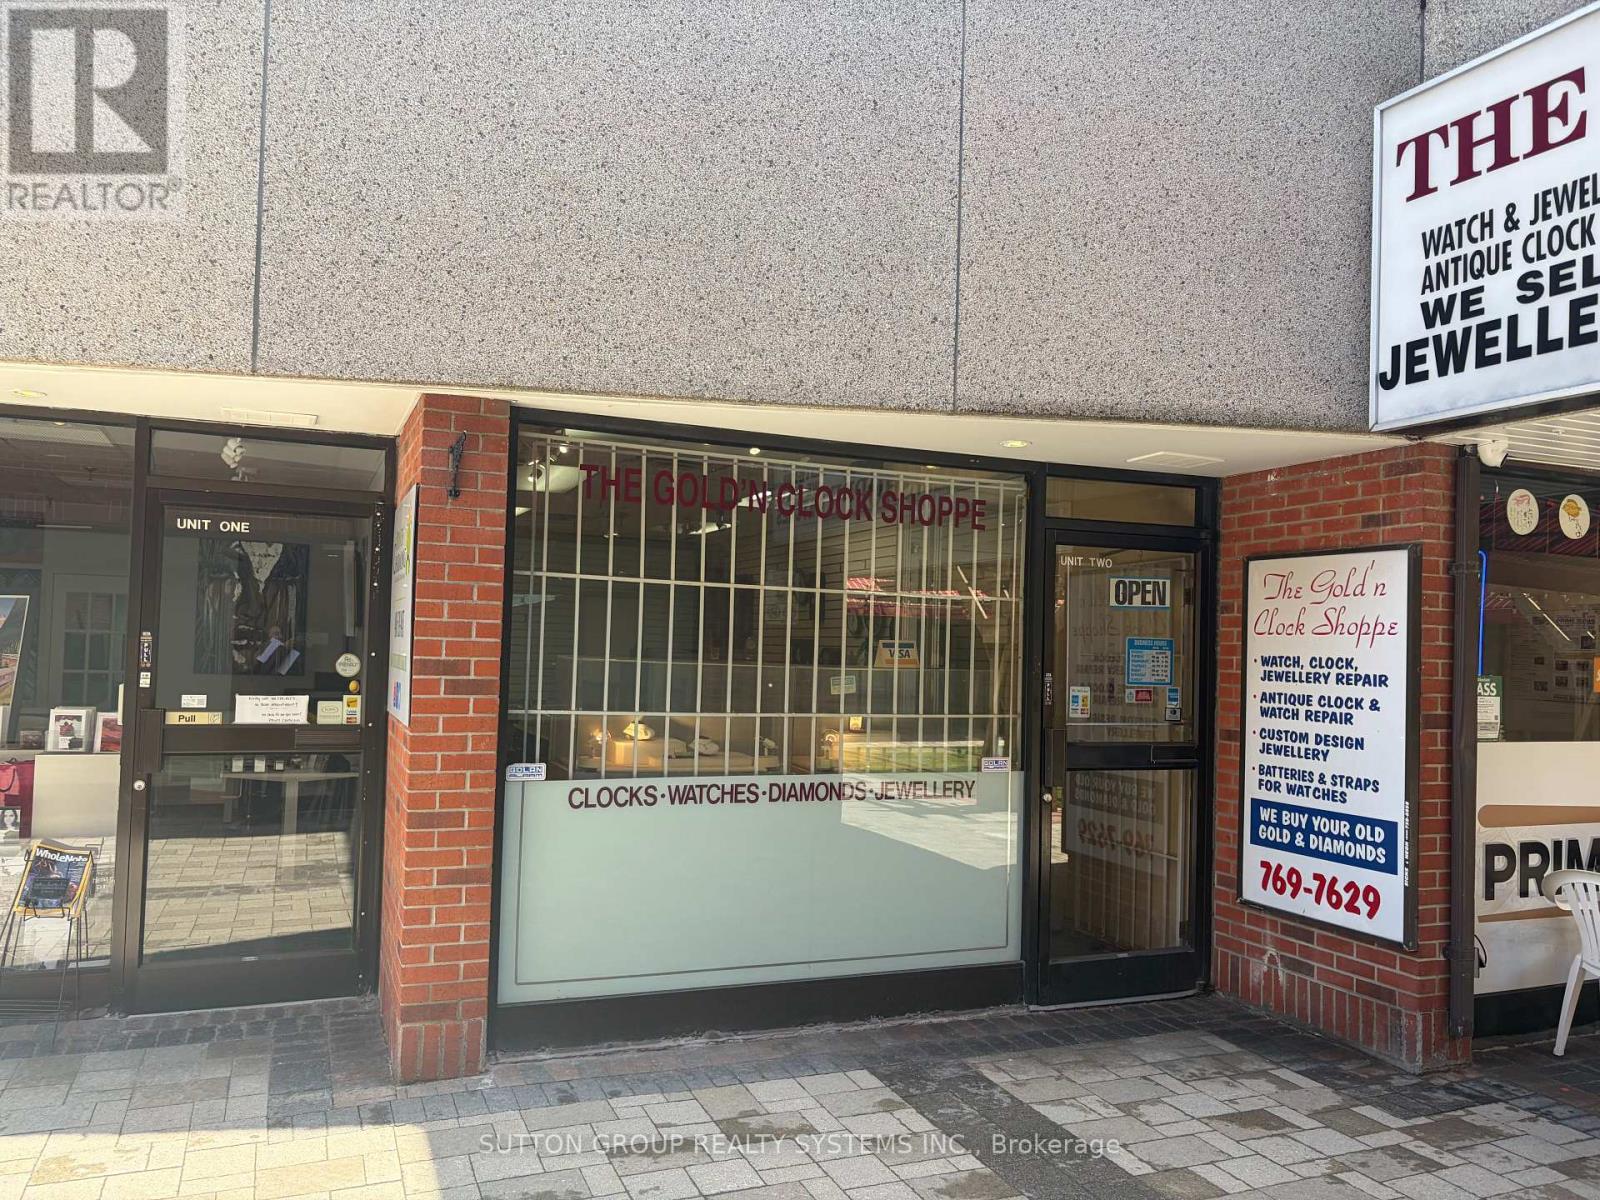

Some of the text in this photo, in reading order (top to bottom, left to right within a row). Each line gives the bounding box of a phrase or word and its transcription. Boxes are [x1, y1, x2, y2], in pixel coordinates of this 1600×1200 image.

[1396, 66, 1588, 203] THE
[1421, 208, 1495, 260] WATCH
[1503, 202, 1521, 233] &
[1421, 213, 1596, 296] ANTIQUE CLOCK
[1420, 254, 1600, 330] WE SEL
[1379, 293, 1599, 391] JEWELLE
[580, 464, 987, 532] THE GOLD'N CLOCK SHOPPE
[176, 517, 251, 534] UNIT ONE
[1060, 556, 1114, 569] UNIT TWO
[1114, 579, 1168, 606] OPEN
[1263, 571, 1303, 600] The
[1253, 605, 1399, 648] Clock Shoppe
[1260, 655, 1359, 672] WATCH, CLOCK,
[1260, 669, 1389, 688] JEWELLERY REPAIR
[1259, 691, 1381, 712] ANTIQUE CLOCK &
[1259, 706, 1354, 726] WATCH REPAIR
[178, 714, 196, 723] Pull
[1258, 742, 1330, 763] JEWELLERY
[1259, 727, 1365, 751] CUSTOM DESIGN
[1257, 778, 1348, 804] FOR WATCHES
[1258, 763, 1380, 793] BATTERIES & STRAPS
[568, 779, 976, 809] CLOCKS WATCHES DIAMONDS JEWELLERY
[1259, 806, 1385, 843] WE BUY YOUR OLD
[1258, 824, 1386, 864] GOLD & DIAMONDS
[1259, 860, 1381, 920] 769-7629
